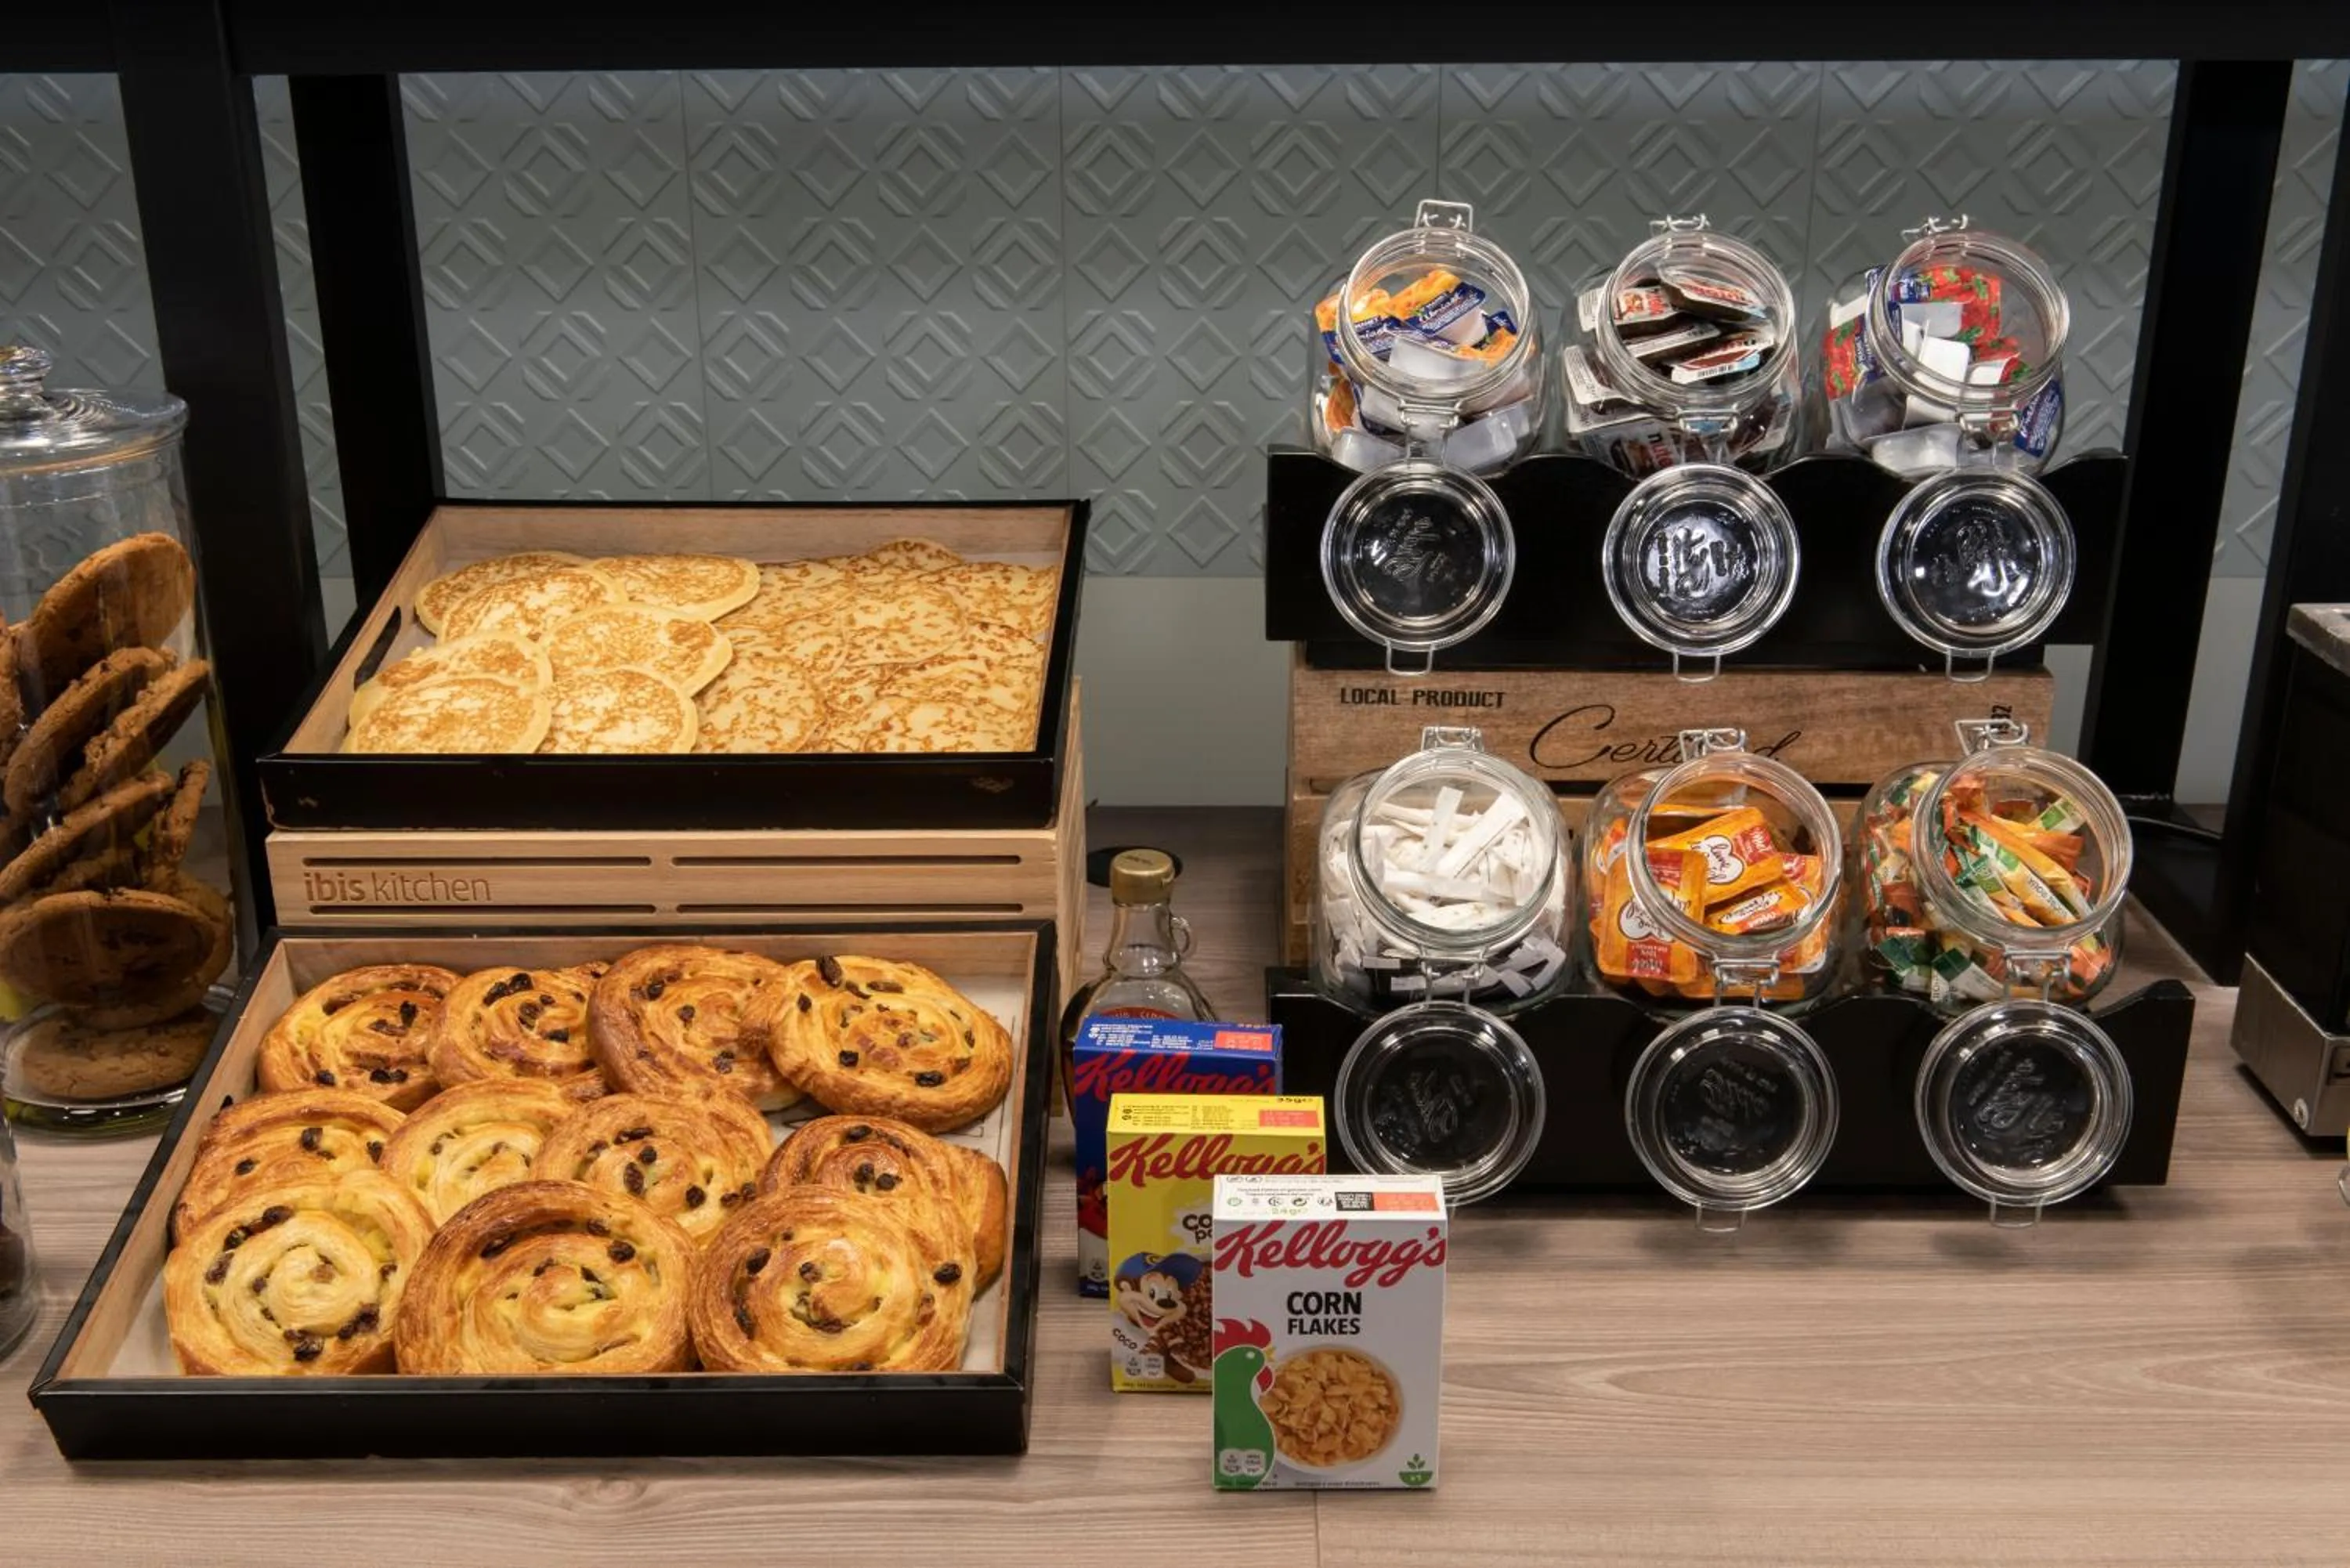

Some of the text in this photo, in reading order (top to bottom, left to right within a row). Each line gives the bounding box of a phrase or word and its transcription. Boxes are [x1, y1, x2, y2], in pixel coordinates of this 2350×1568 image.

[1647, 433, 1674, 468] nute
[1340, 687, 1506, 708] LOCAL PRODUCT
[304, 872, 492, 901] ibis kitchen
[1214, 1219, 1446, 1288] Kellogg's
[1286, 1291, 1362, 1316] CORN
[1287, 1317, 1361, 1335] FLAKES
